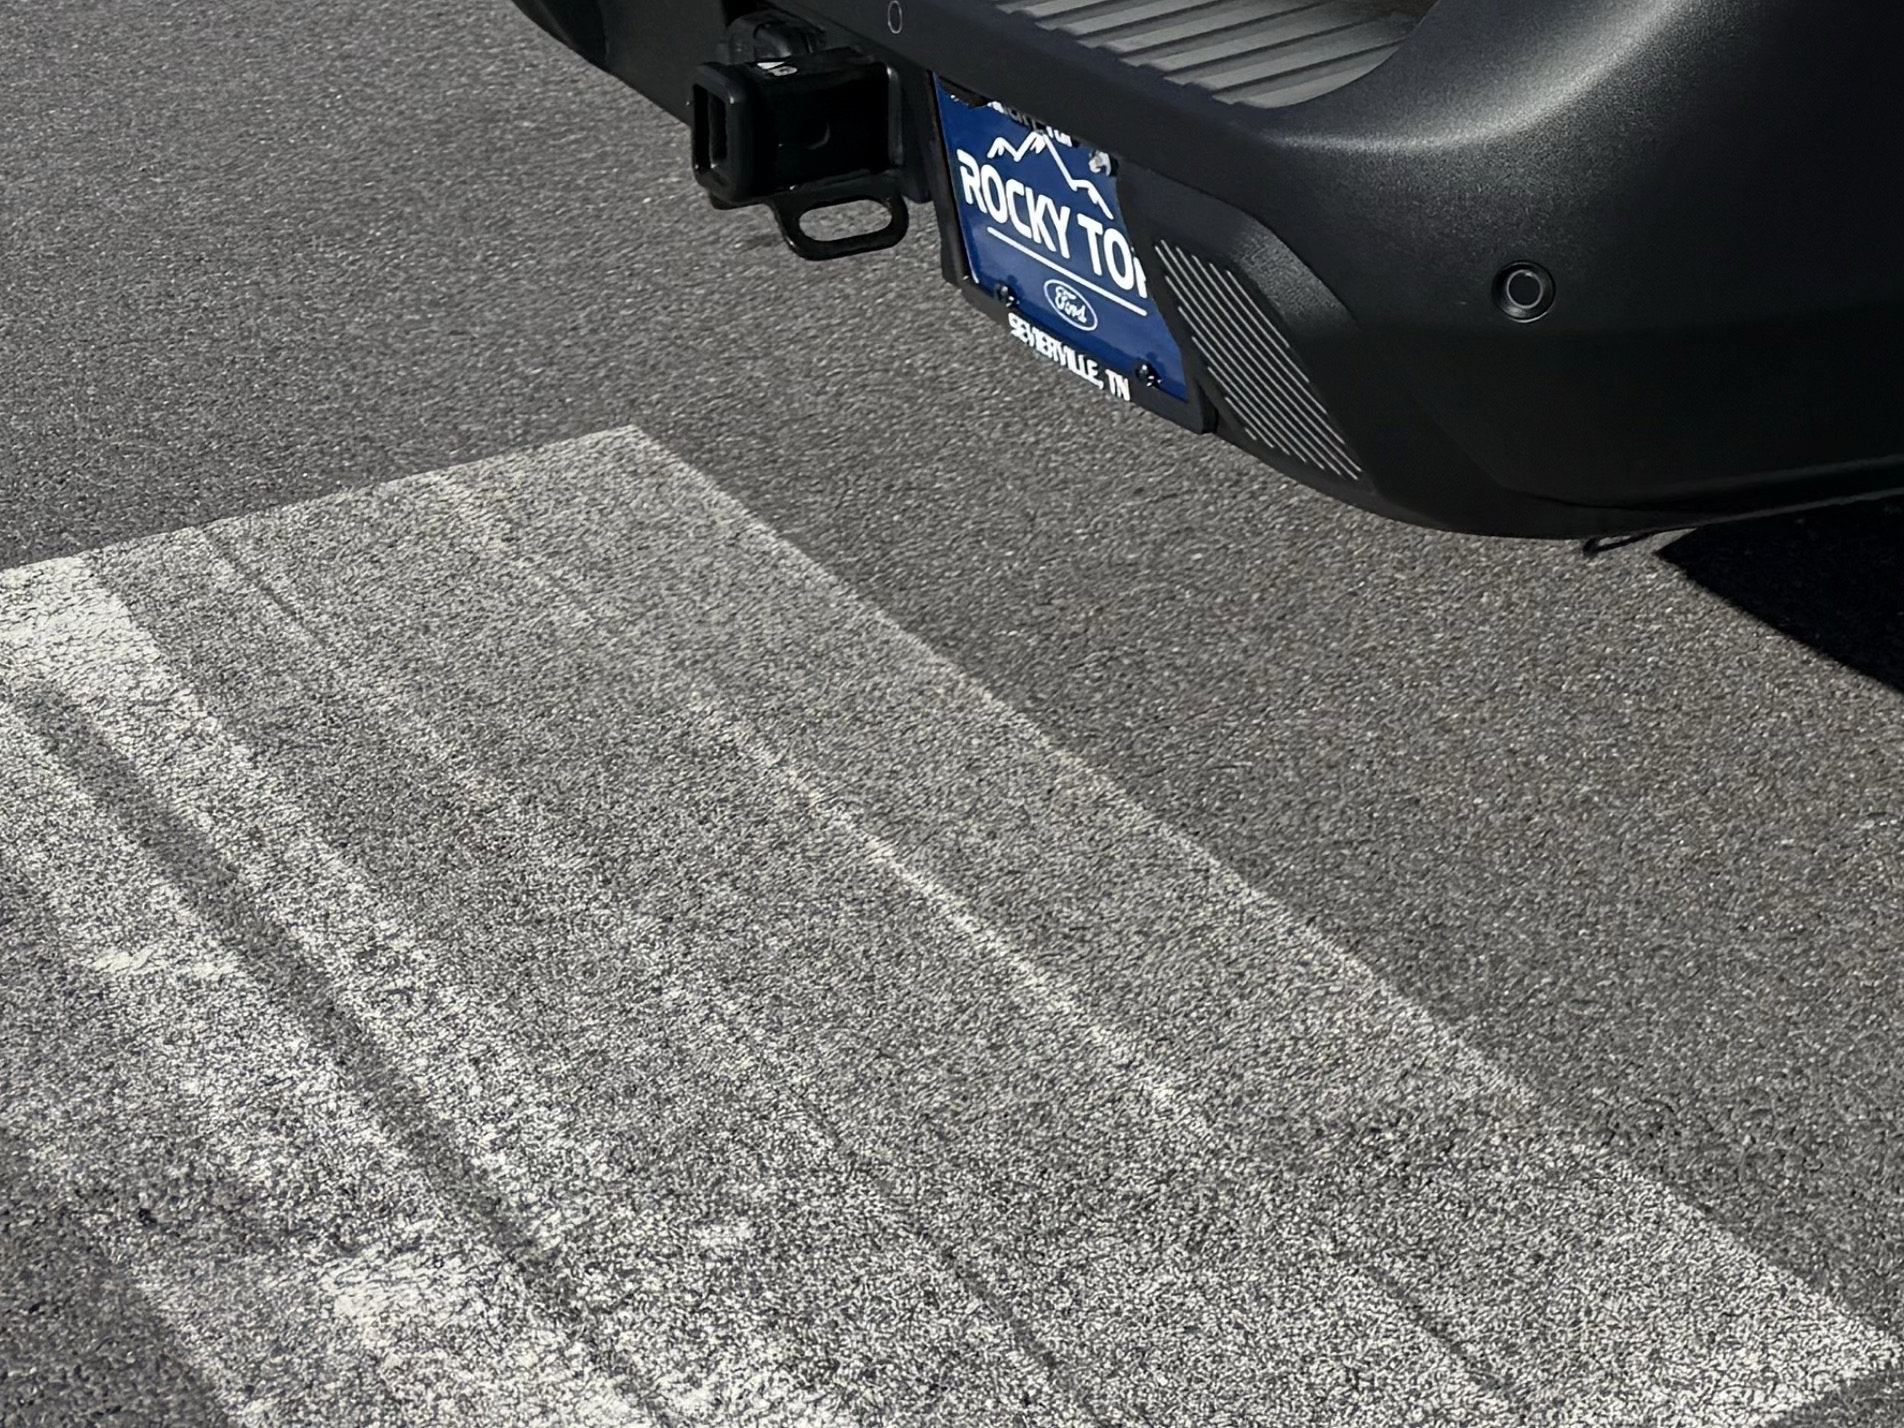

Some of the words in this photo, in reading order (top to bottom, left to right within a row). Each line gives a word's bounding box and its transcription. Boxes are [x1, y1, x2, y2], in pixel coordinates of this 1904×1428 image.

[956, 148, 1071, 260] ROCKY
[1054, 287, 1087, 324] Ford
[1105, 368, 1130, 401] TN
